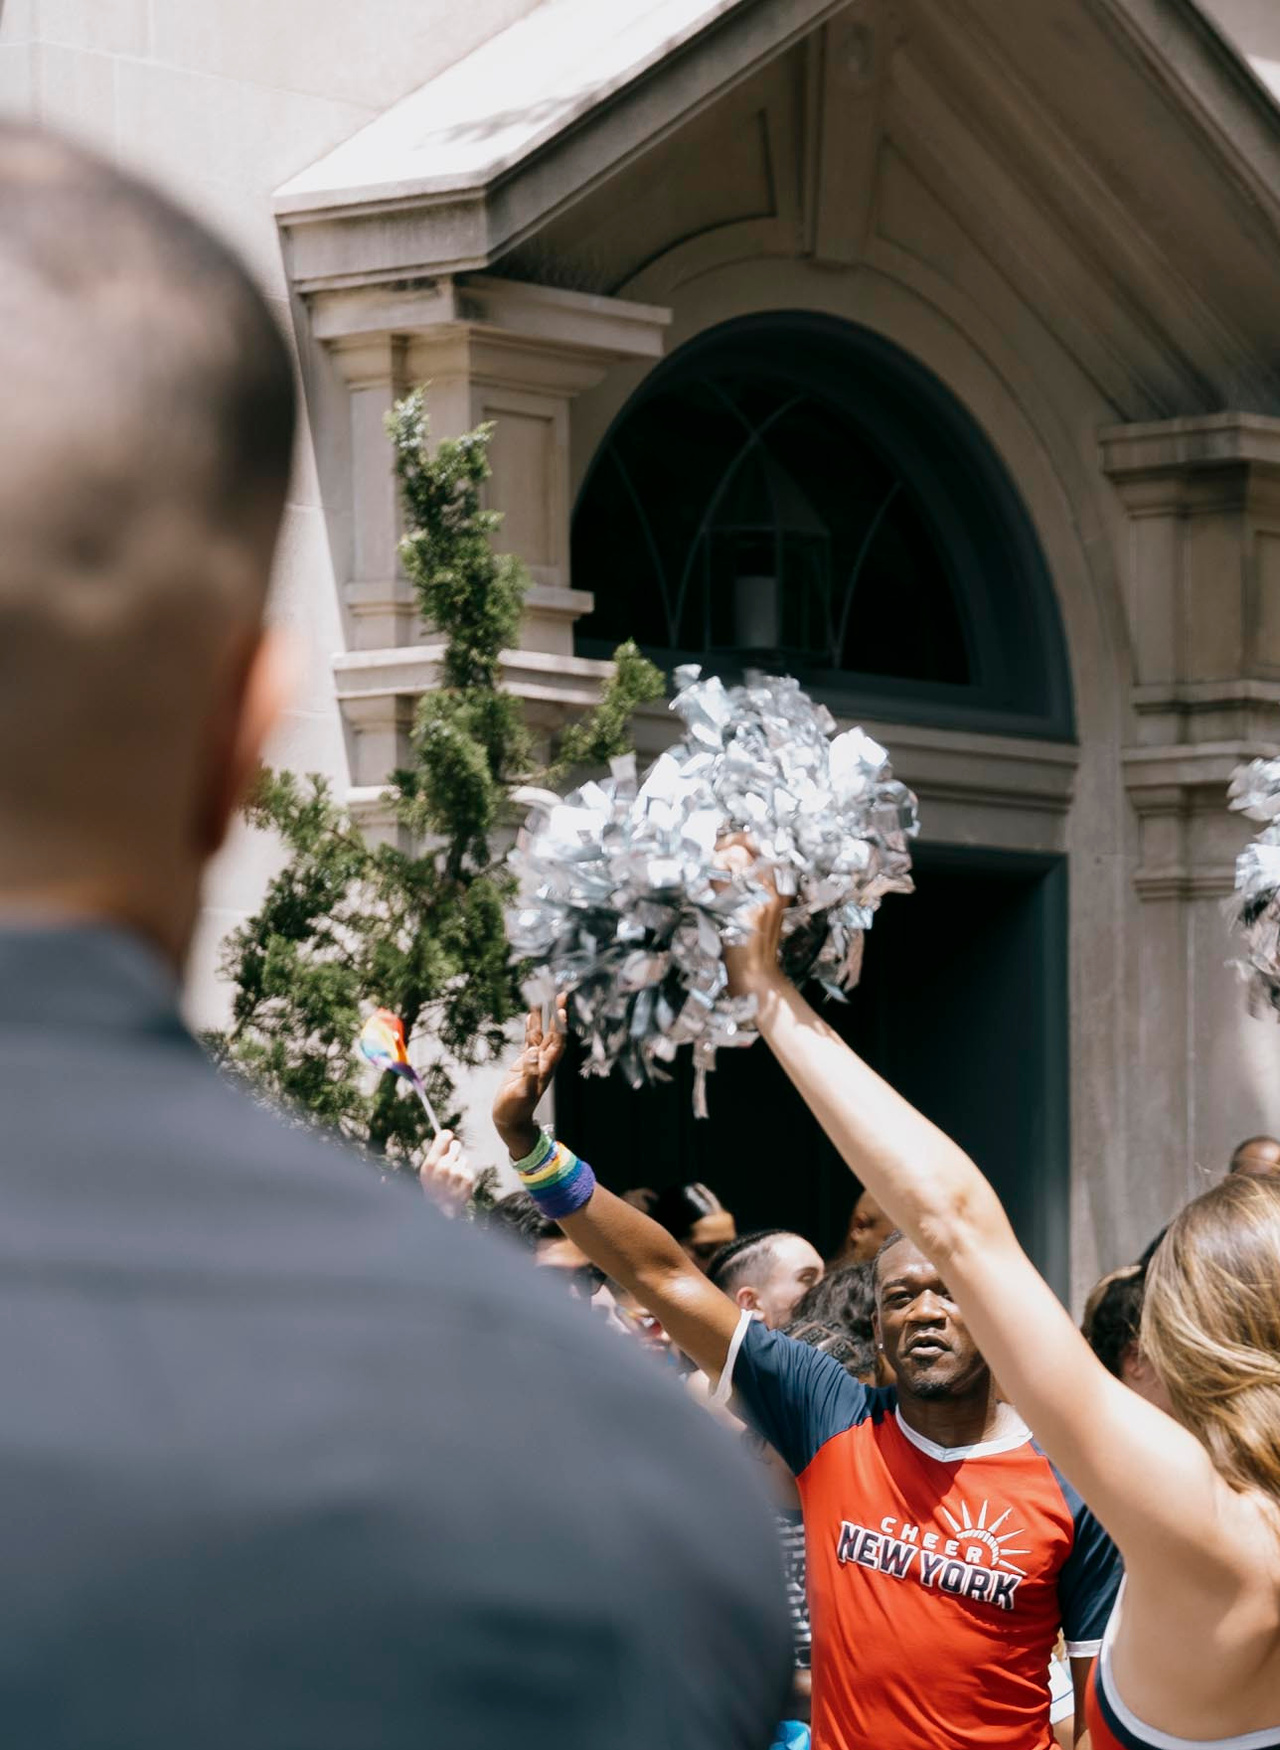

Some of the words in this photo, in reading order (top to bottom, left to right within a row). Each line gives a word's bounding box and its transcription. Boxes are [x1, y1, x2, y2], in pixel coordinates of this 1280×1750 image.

[837, 1520, 919, 1579] NEW
[919, 1550, 1022, 1610] YORK
[880, 1516, 983, 1564] CHEER
